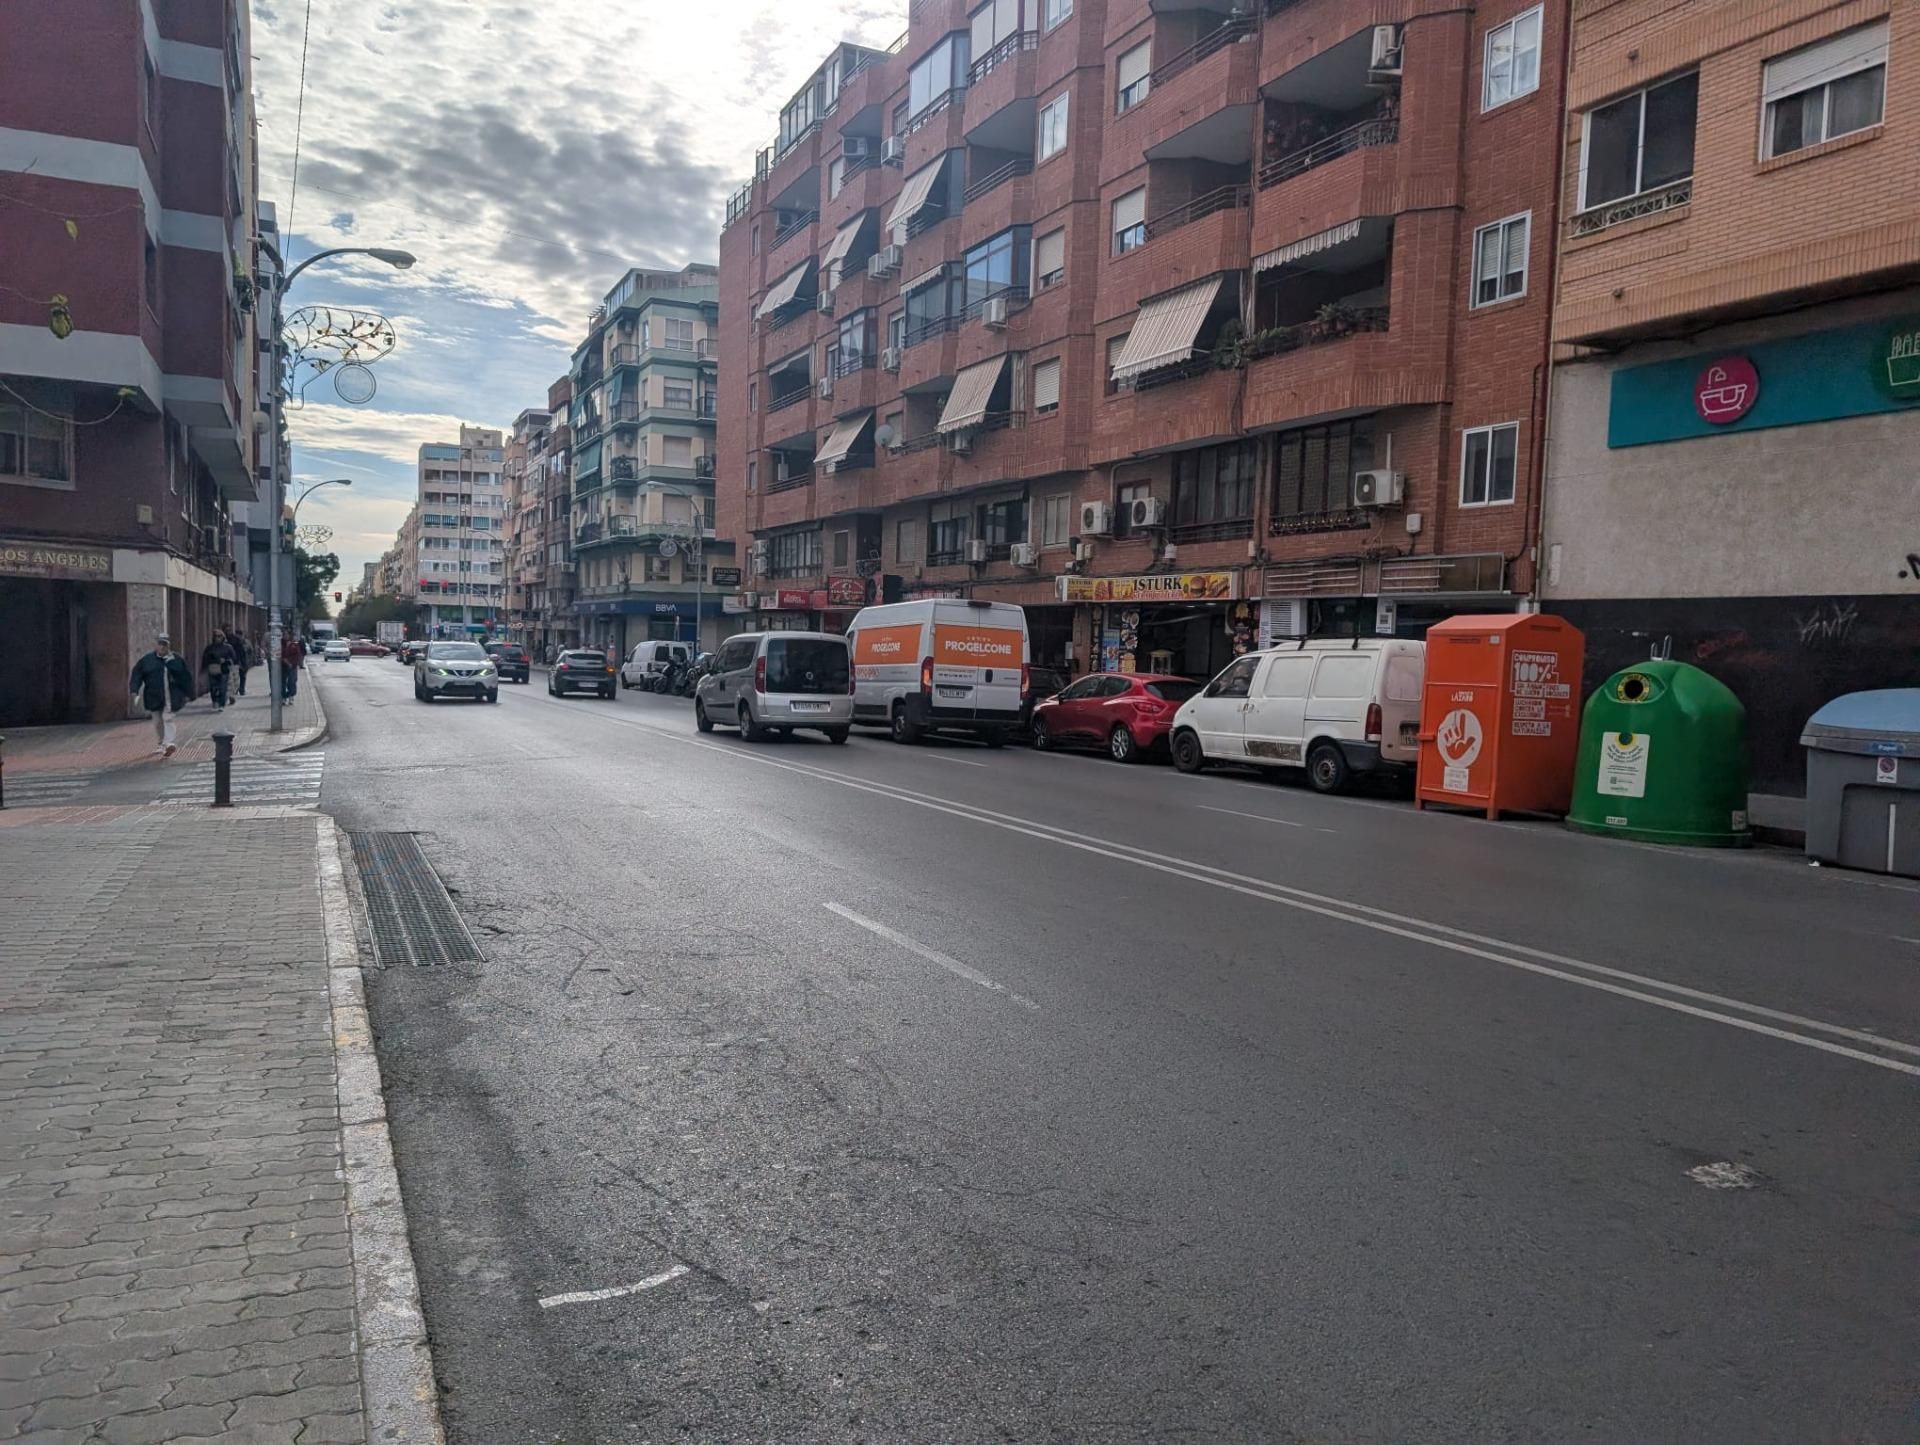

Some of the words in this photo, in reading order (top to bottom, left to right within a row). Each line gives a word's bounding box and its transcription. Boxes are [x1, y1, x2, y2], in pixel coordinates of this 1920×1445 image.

[32, 552, 109, 570] ANGELES
[1134, 577, 1183, 592] ISTURK
[655, 604, 677, 612] BBVA
[871, 642, 901, 653] PROGELCONE
[945, 640, 1012, 655] PROGELCONE
[1514, 662, 1552, 682] 100%
